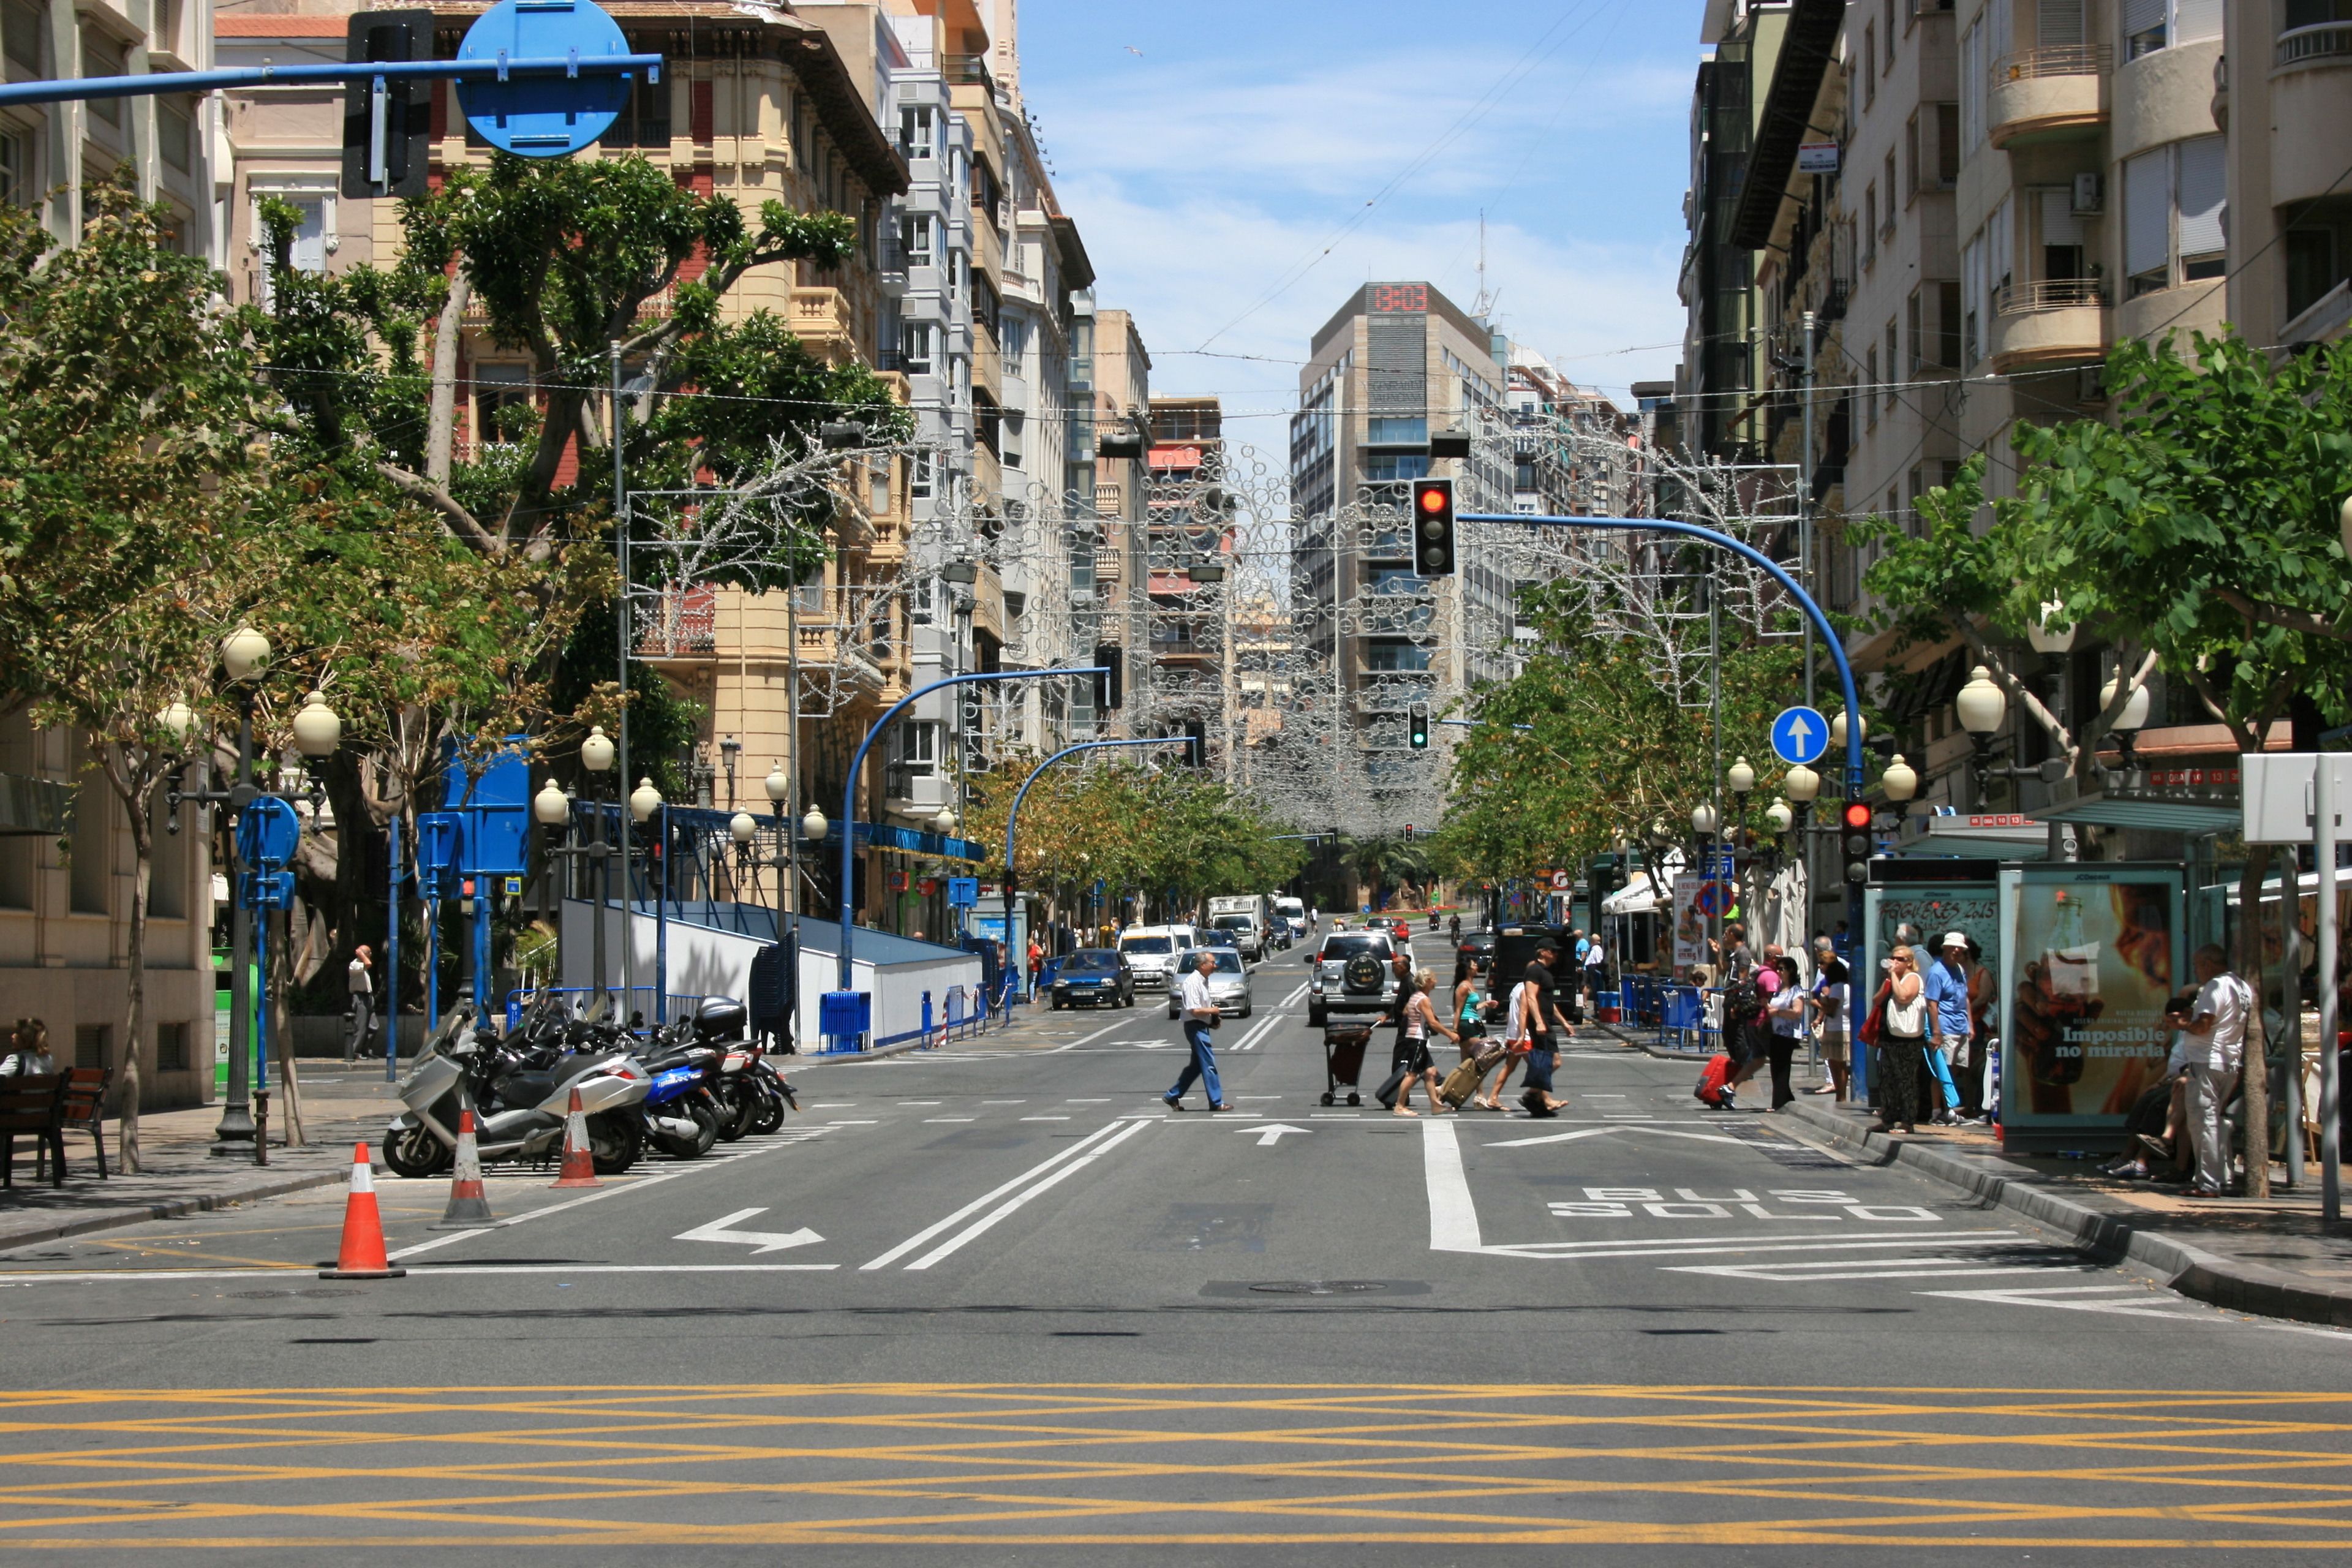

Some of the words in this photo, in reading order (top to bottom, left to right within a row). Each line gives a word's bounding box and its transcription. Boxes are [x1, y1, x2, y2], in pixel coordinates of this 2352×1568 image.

[1375, 285, 1427, 311] 13:03
[2169, 774, 2184, 783] 08A
[2063, 1027, 2165, 1044] Imposible
[2056, 1045, 2081, 1057] no
[2087, 1042, 2166, 1057] mirarla
[1583, 1187, 1860, 1203] BUS
[1547, 1202, 1943, 1221] SOLO
